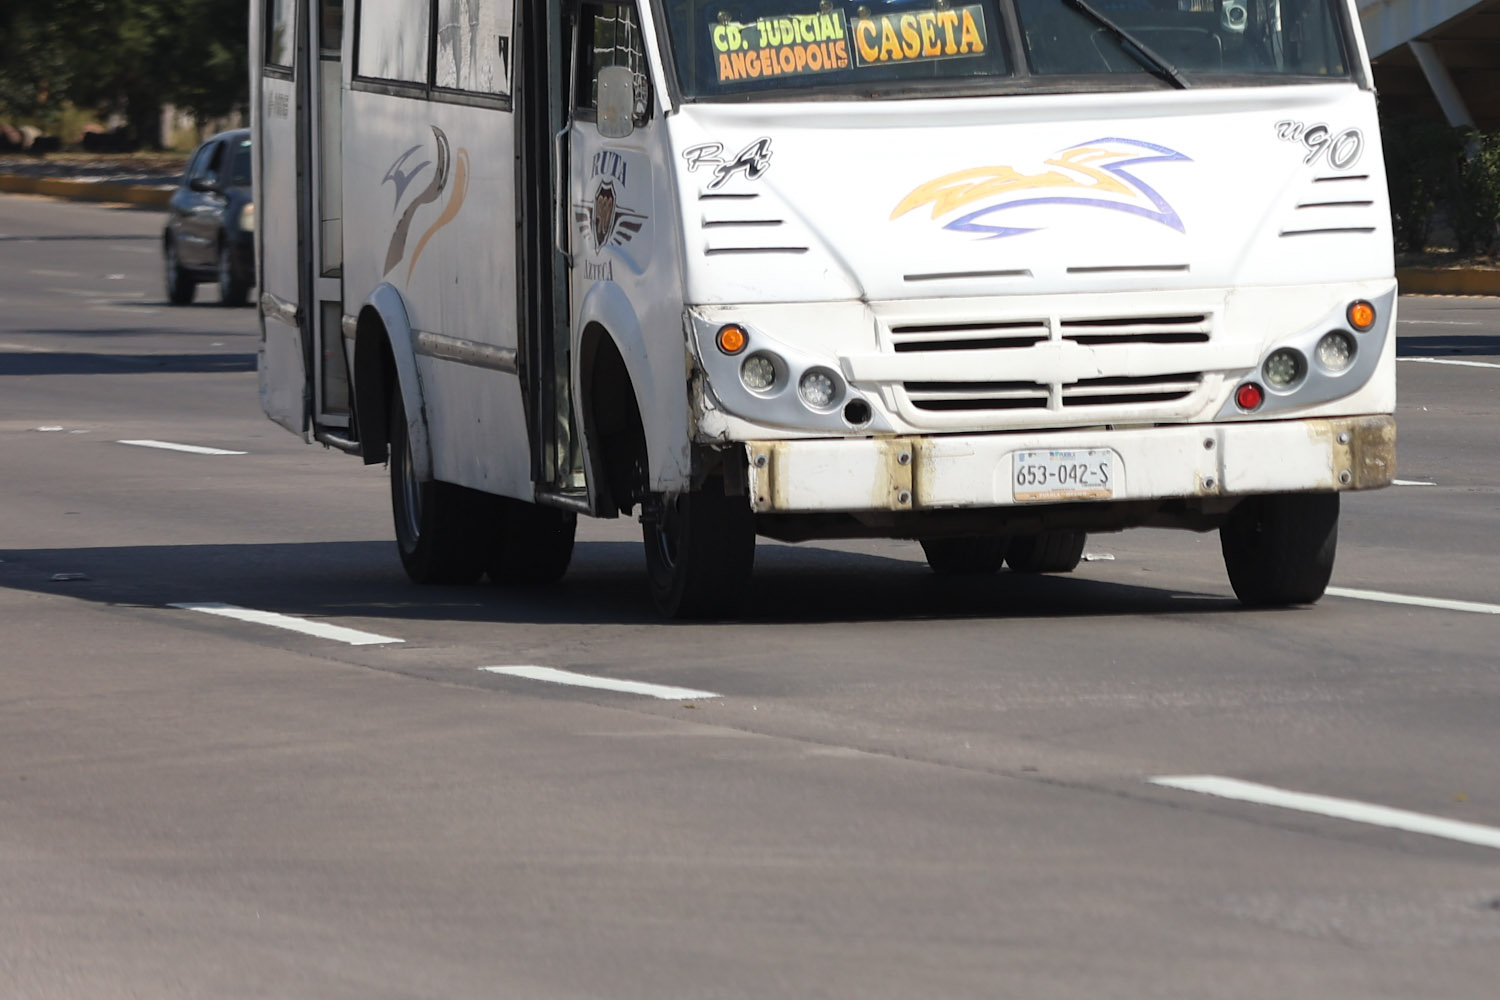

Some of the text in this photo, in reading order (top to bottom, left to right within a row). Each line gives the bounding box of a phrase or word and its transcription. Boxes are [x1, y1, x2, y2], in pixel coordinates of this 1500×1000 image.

[713, 12, 844, 52] CD. JUDICIAL
[856, 8, 985, 62] CASETA
[719, 40, 849, 81] ANGELOPOLIS
[591, 151, 627, 188] RUTA
[584, 259, 614, 281] AZTECA
[1017, 463, 1109, 486] 653-042-S
